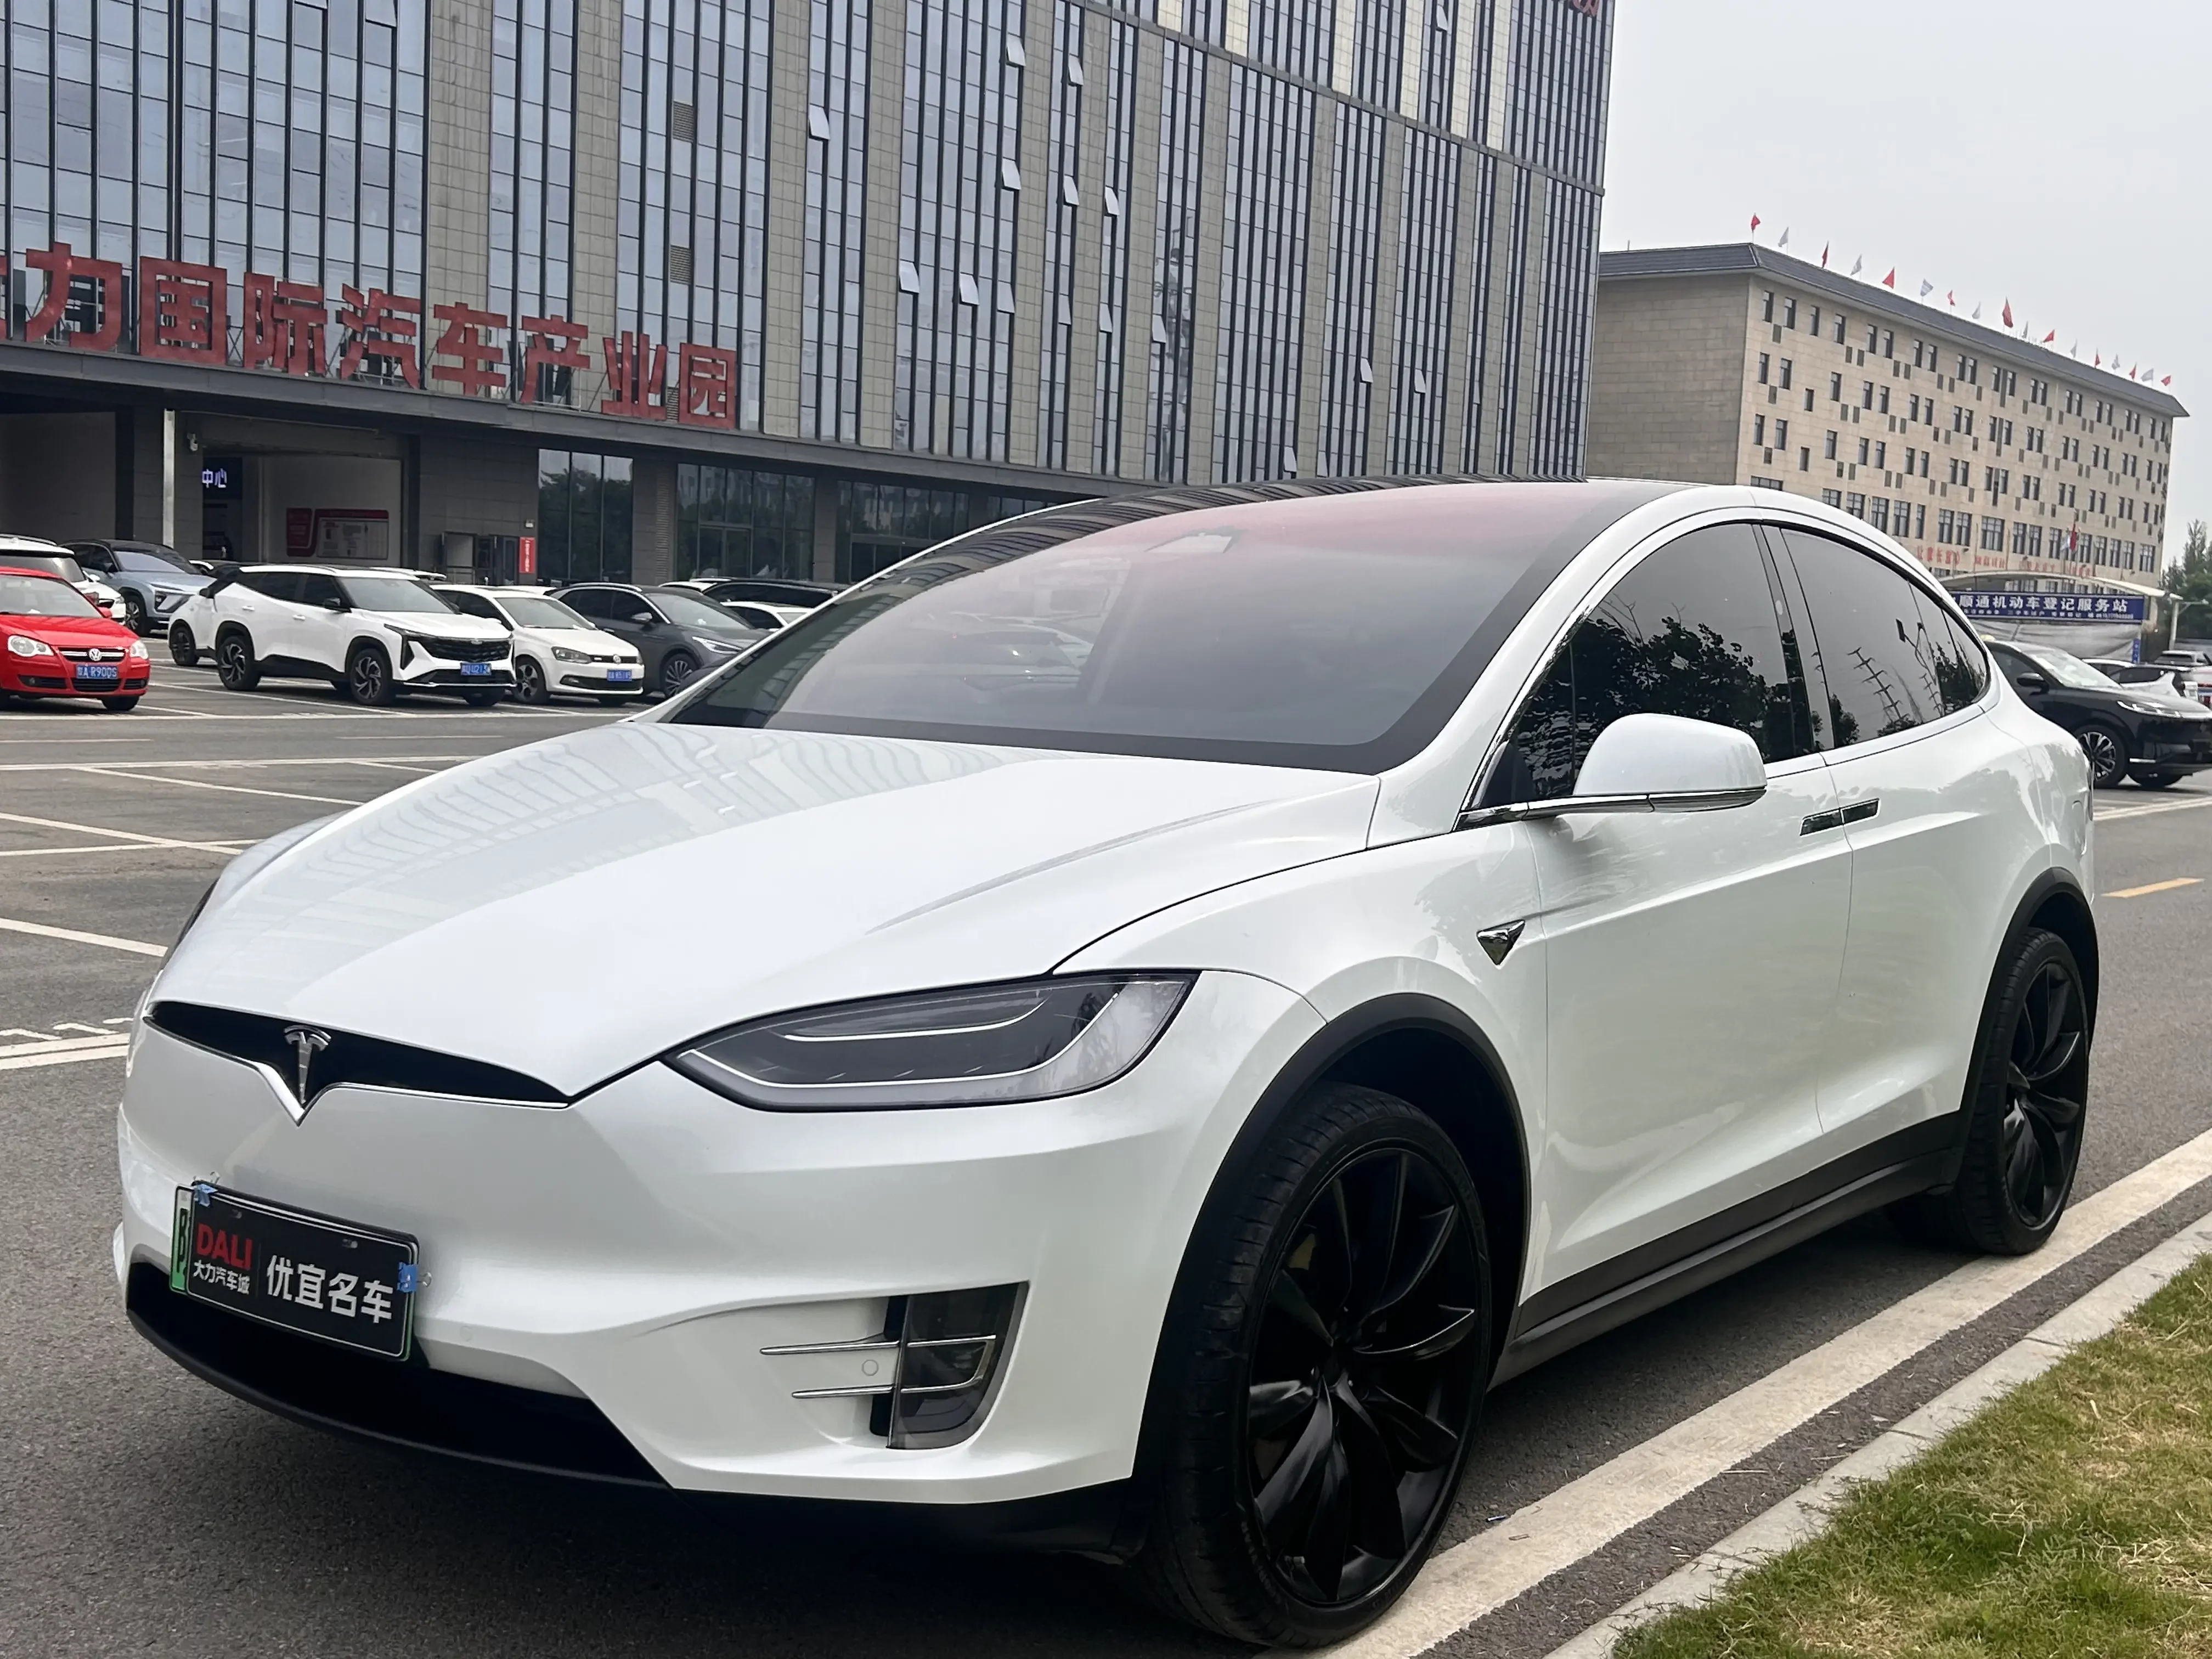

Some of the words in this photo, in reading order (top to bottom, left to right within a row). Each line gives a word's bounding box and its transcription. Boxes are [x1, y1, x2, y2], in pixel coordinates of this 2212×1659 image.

[0, 242, 736, 429] 力国际汽车产业园
[201, 468, 227, 488] 中心
[1954, 595, 2128, 613] 顺通机动车登记服务站
[196, 1223, 252, 1270] DALI
[193, 1260, 251, 1295] 大力汽车城
[267, 1254, 394, 1324] 优宜名车
